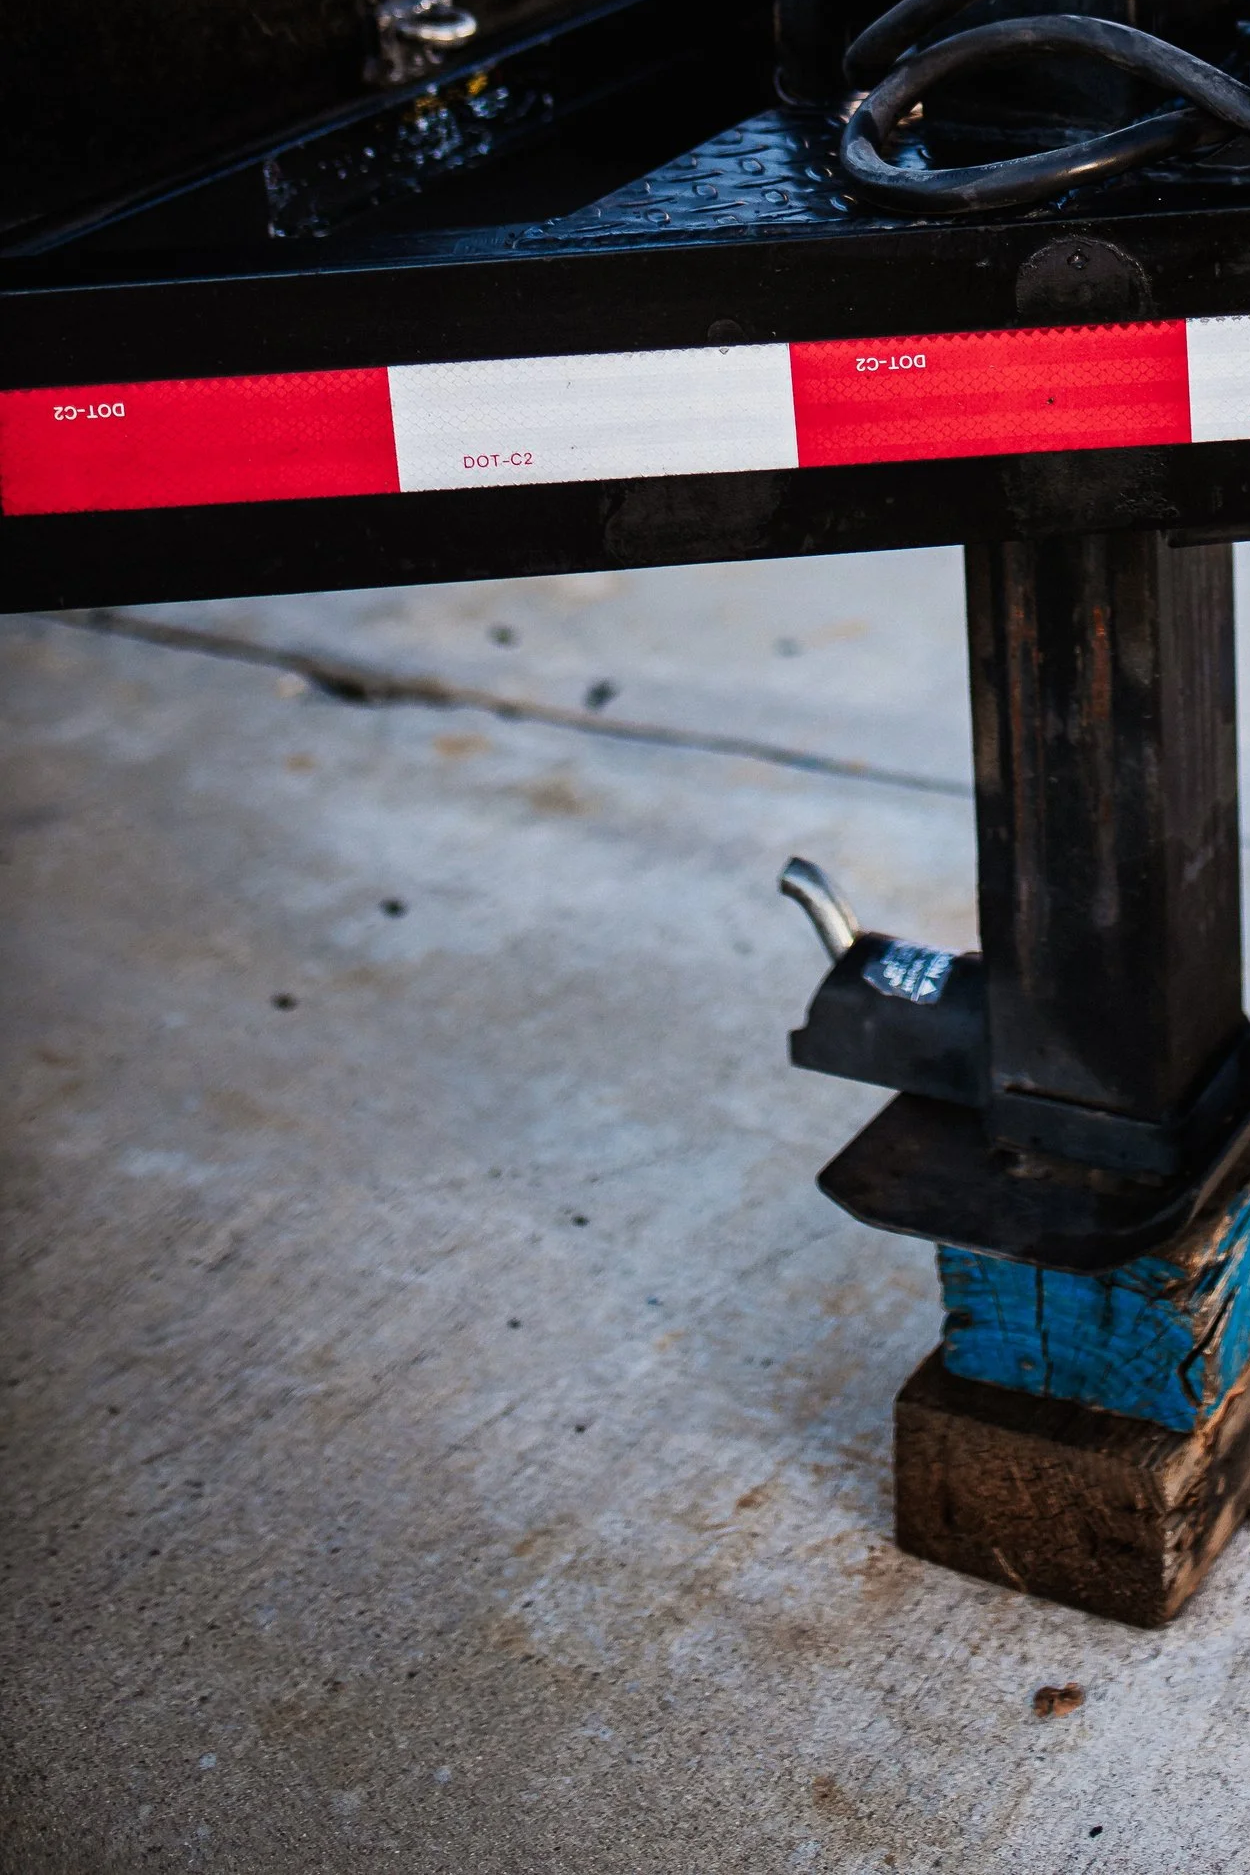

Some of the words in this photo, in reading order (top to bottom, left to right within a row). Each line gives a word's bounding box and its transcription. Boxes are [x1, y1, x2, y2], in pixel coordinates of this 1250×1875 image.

[856, 354, 925, 371] DOT-C2
[54, 403, 125, 421] DOT-C2
[464, 452, 532, 469] DOT-C2
